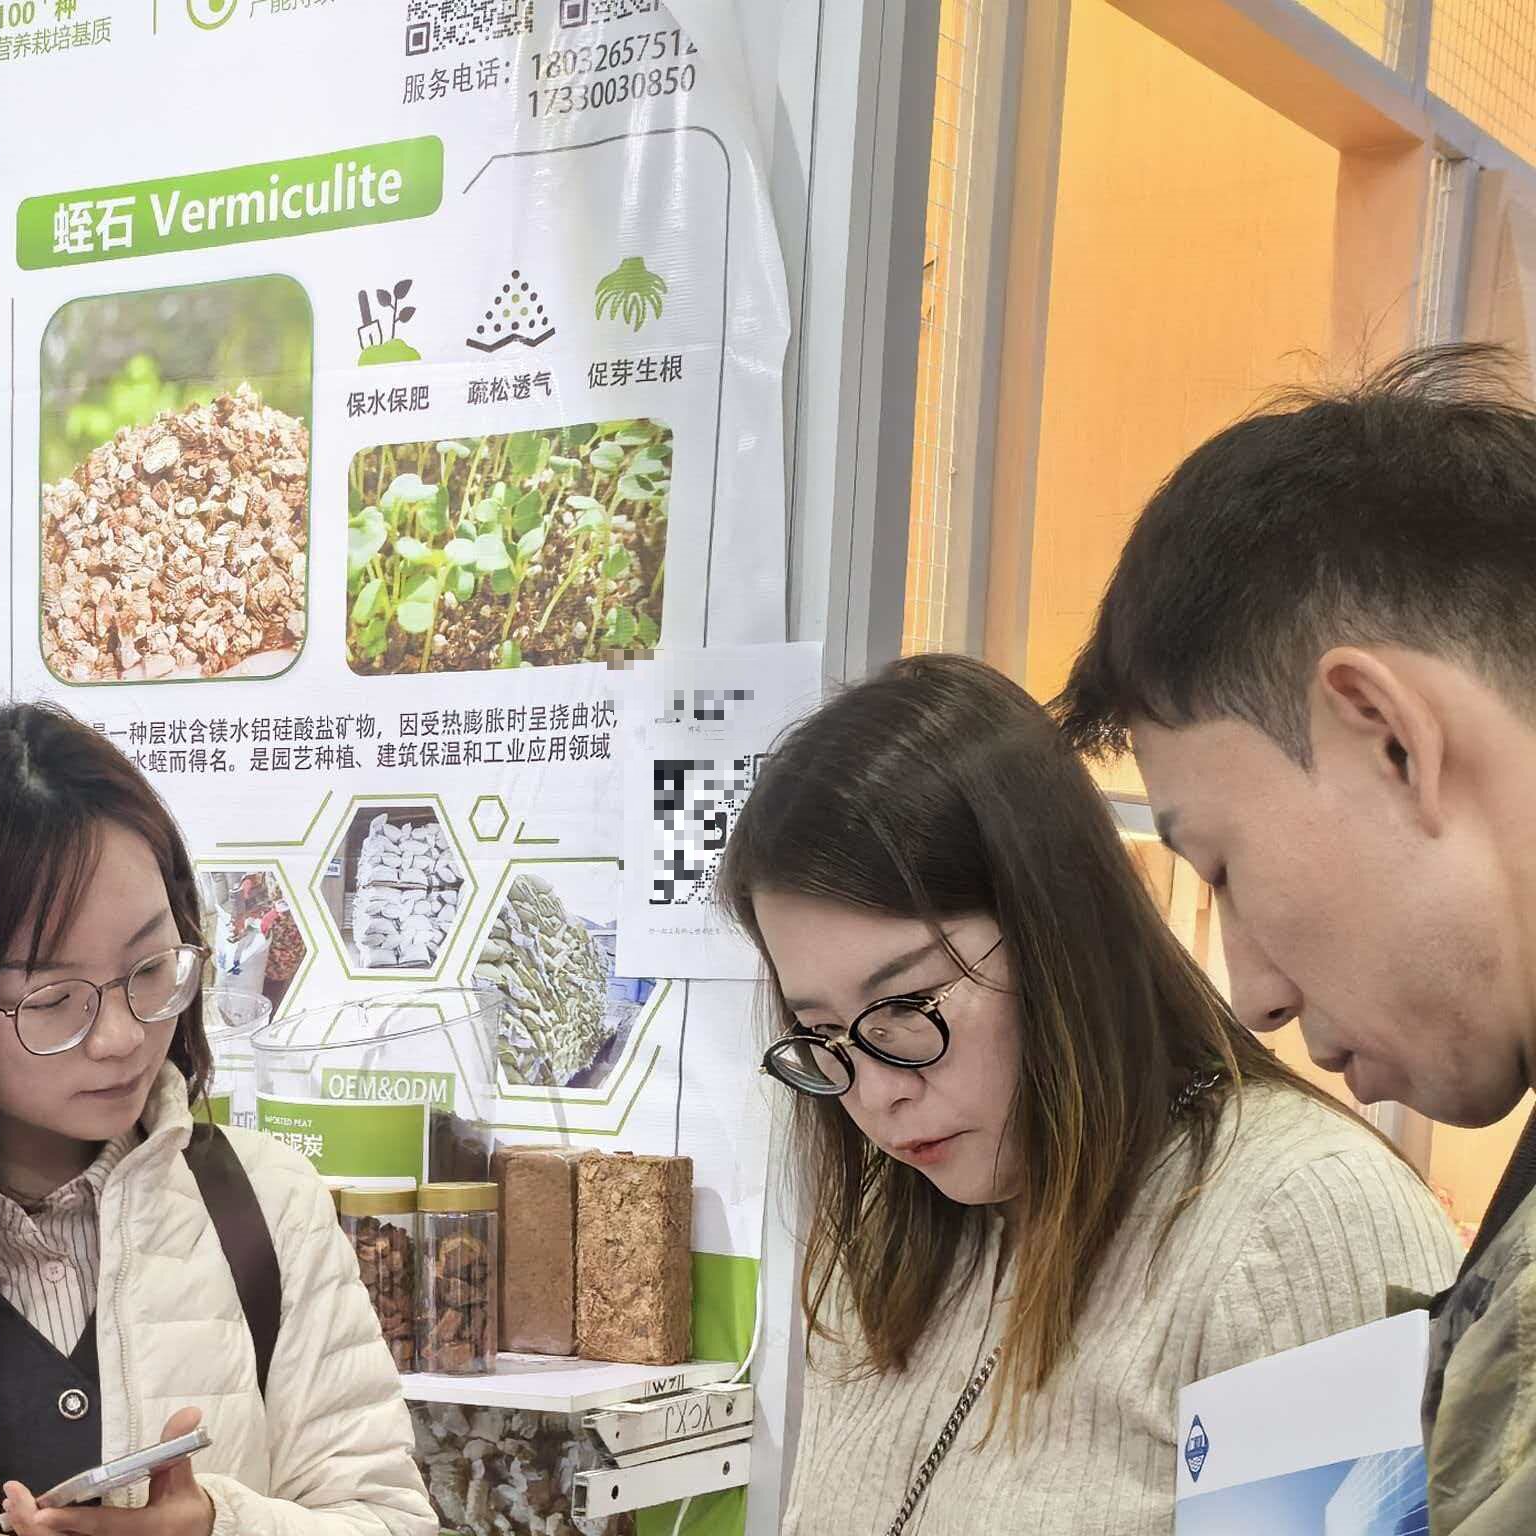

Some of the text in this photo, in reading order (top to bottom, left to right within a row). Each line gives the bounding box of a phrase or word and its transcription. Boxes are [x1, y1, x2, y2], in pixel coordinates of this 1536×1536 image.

[529, 64, 696, 117] 17330030850
[52, 161, 402, 256] 蛭石 Vermiculite
[467, 371, 553, 405] 疏松透气
[587, 355, 683, 390] 促芽生根
[346, 385, 431, 418] 保水保肥
[328, 1075, 448, 1104] OEM&ODM
